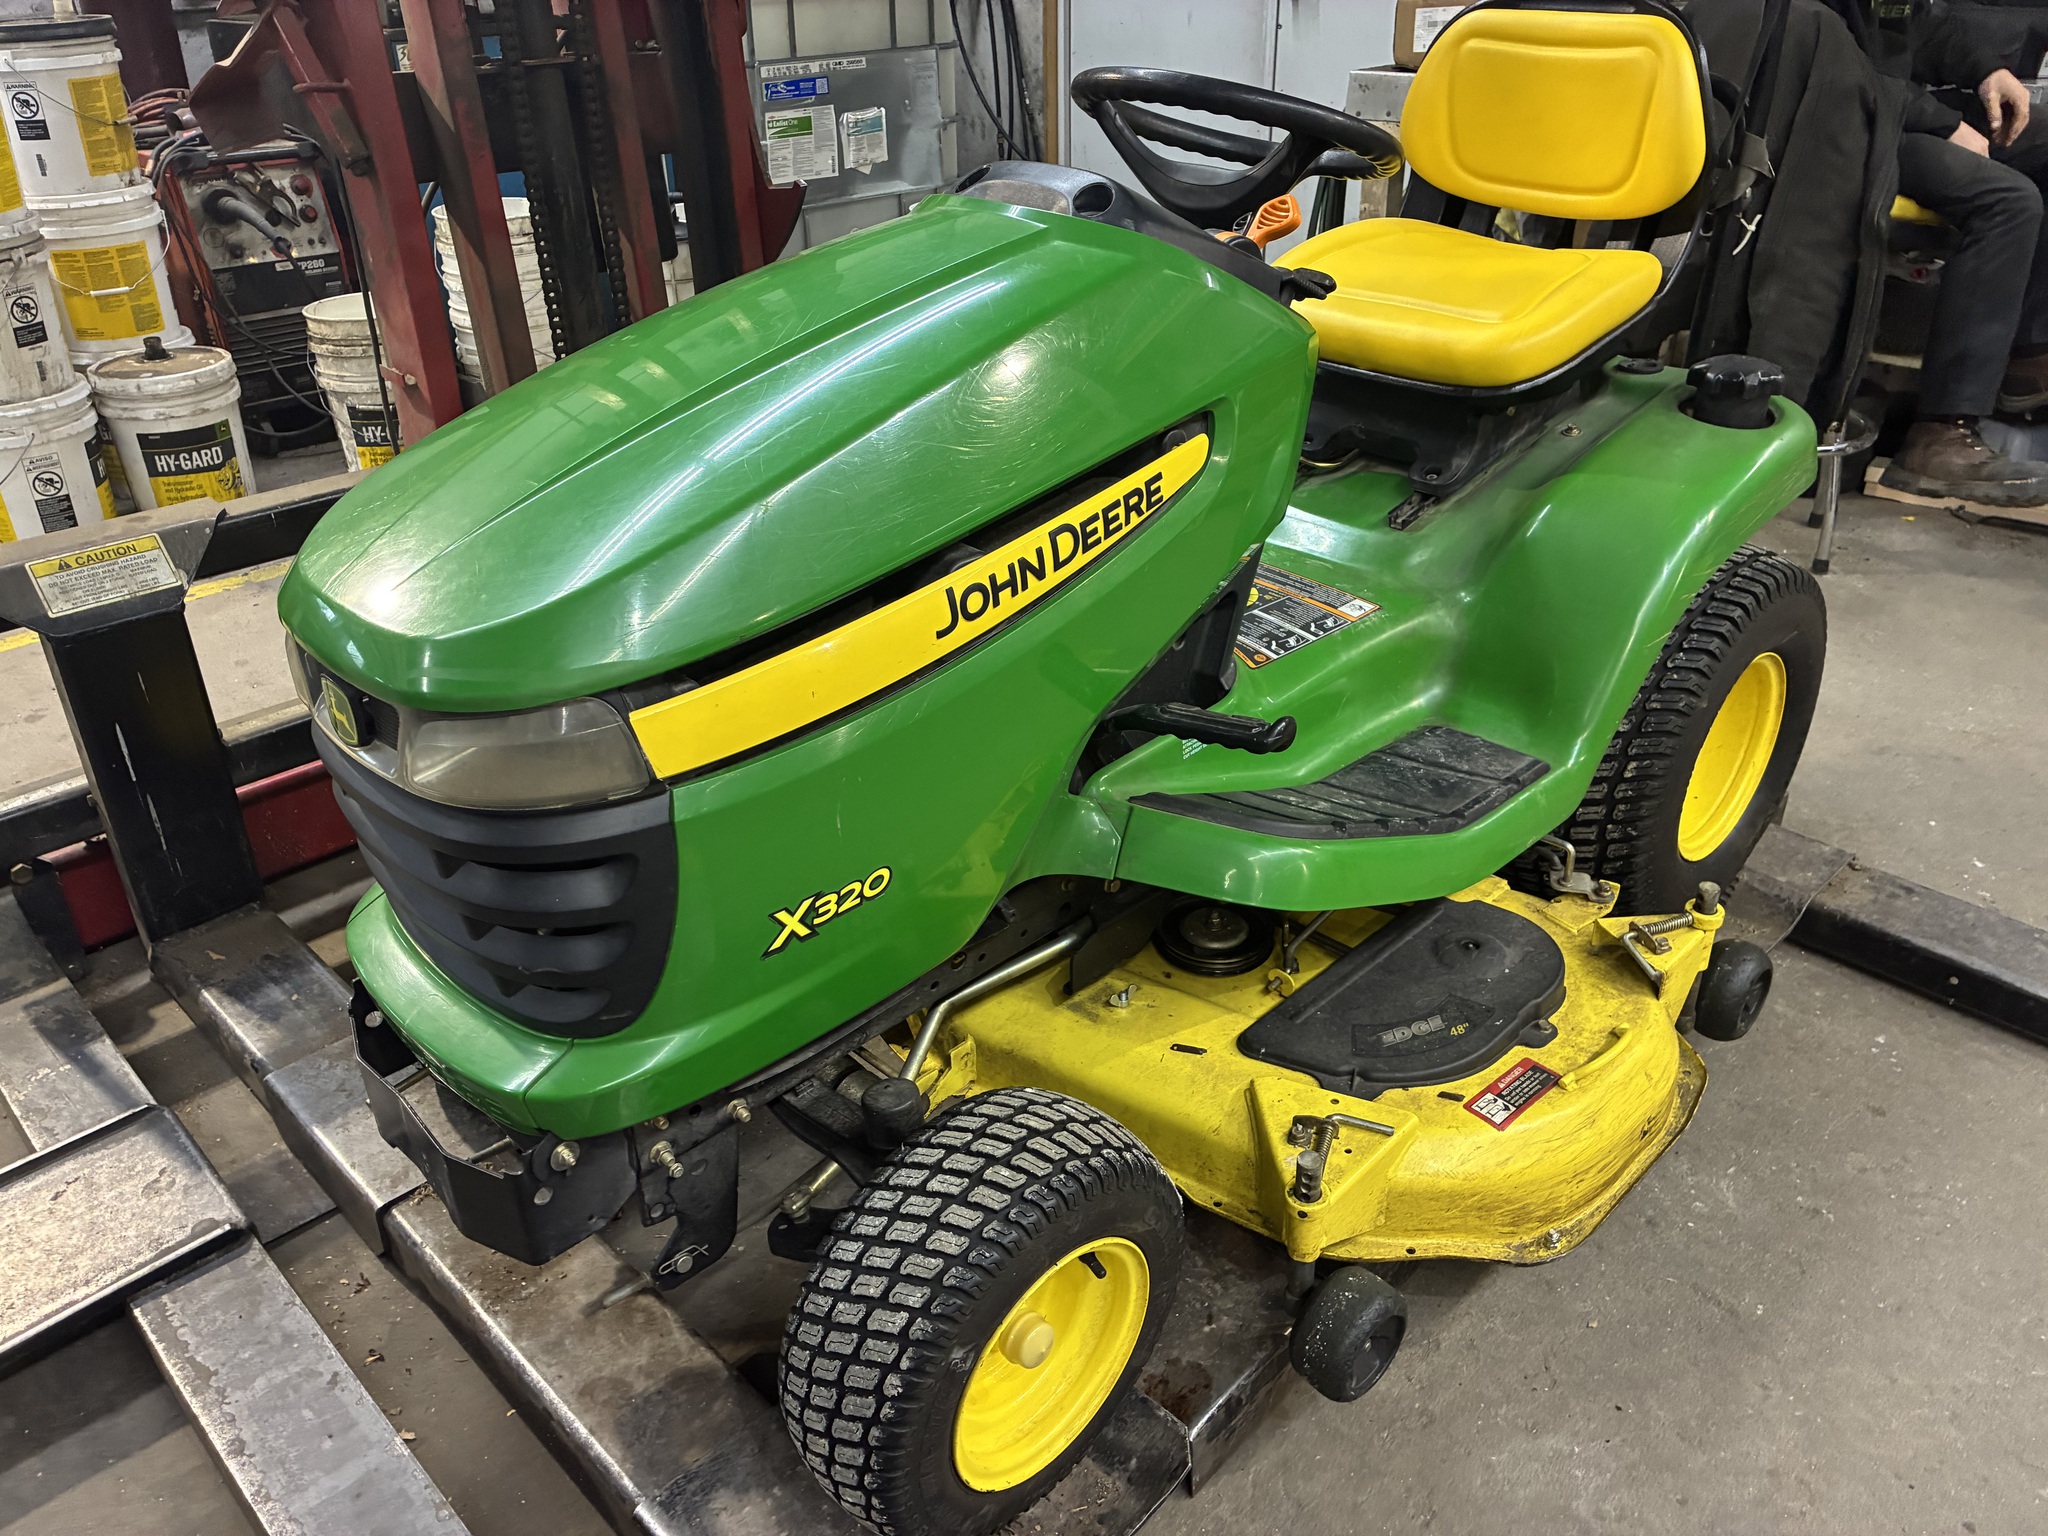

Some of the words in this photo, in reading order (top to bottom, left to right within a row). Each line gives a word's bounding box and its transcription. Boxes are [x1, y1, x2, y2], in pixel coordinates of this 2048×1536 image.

[35, 455, 54, 464] AVISO
[154, 446, 223, 472] HY-GARD
[65, 568, 86, 578] AVOID
[86, 560, 120, 573] CRUSHING
[120, 554, 147, 565] HAZARD
[75, 544, 137, 566] CAUTION
[936, 546, 1047, 640] JOHN
[1048, 472, 1164, 572] DEERE
[59, 577, 74, 586] NOT
[74, 571, 101, 581] EXCEED
[118, 562, 140, 571] RATED
[140, 557, 158, 566] LOAD
[761, 866, 892, 960] X320
[1377, 1015, 1446, 1048] EDGE
[1450, 1022, 1469, 1036] 48"
[1501, 1066, 1524, 1084] DANGER
[1501, 1079, 1522, 1096] ROTATING
[1519, 1070, 1534, 1082] BLADE
